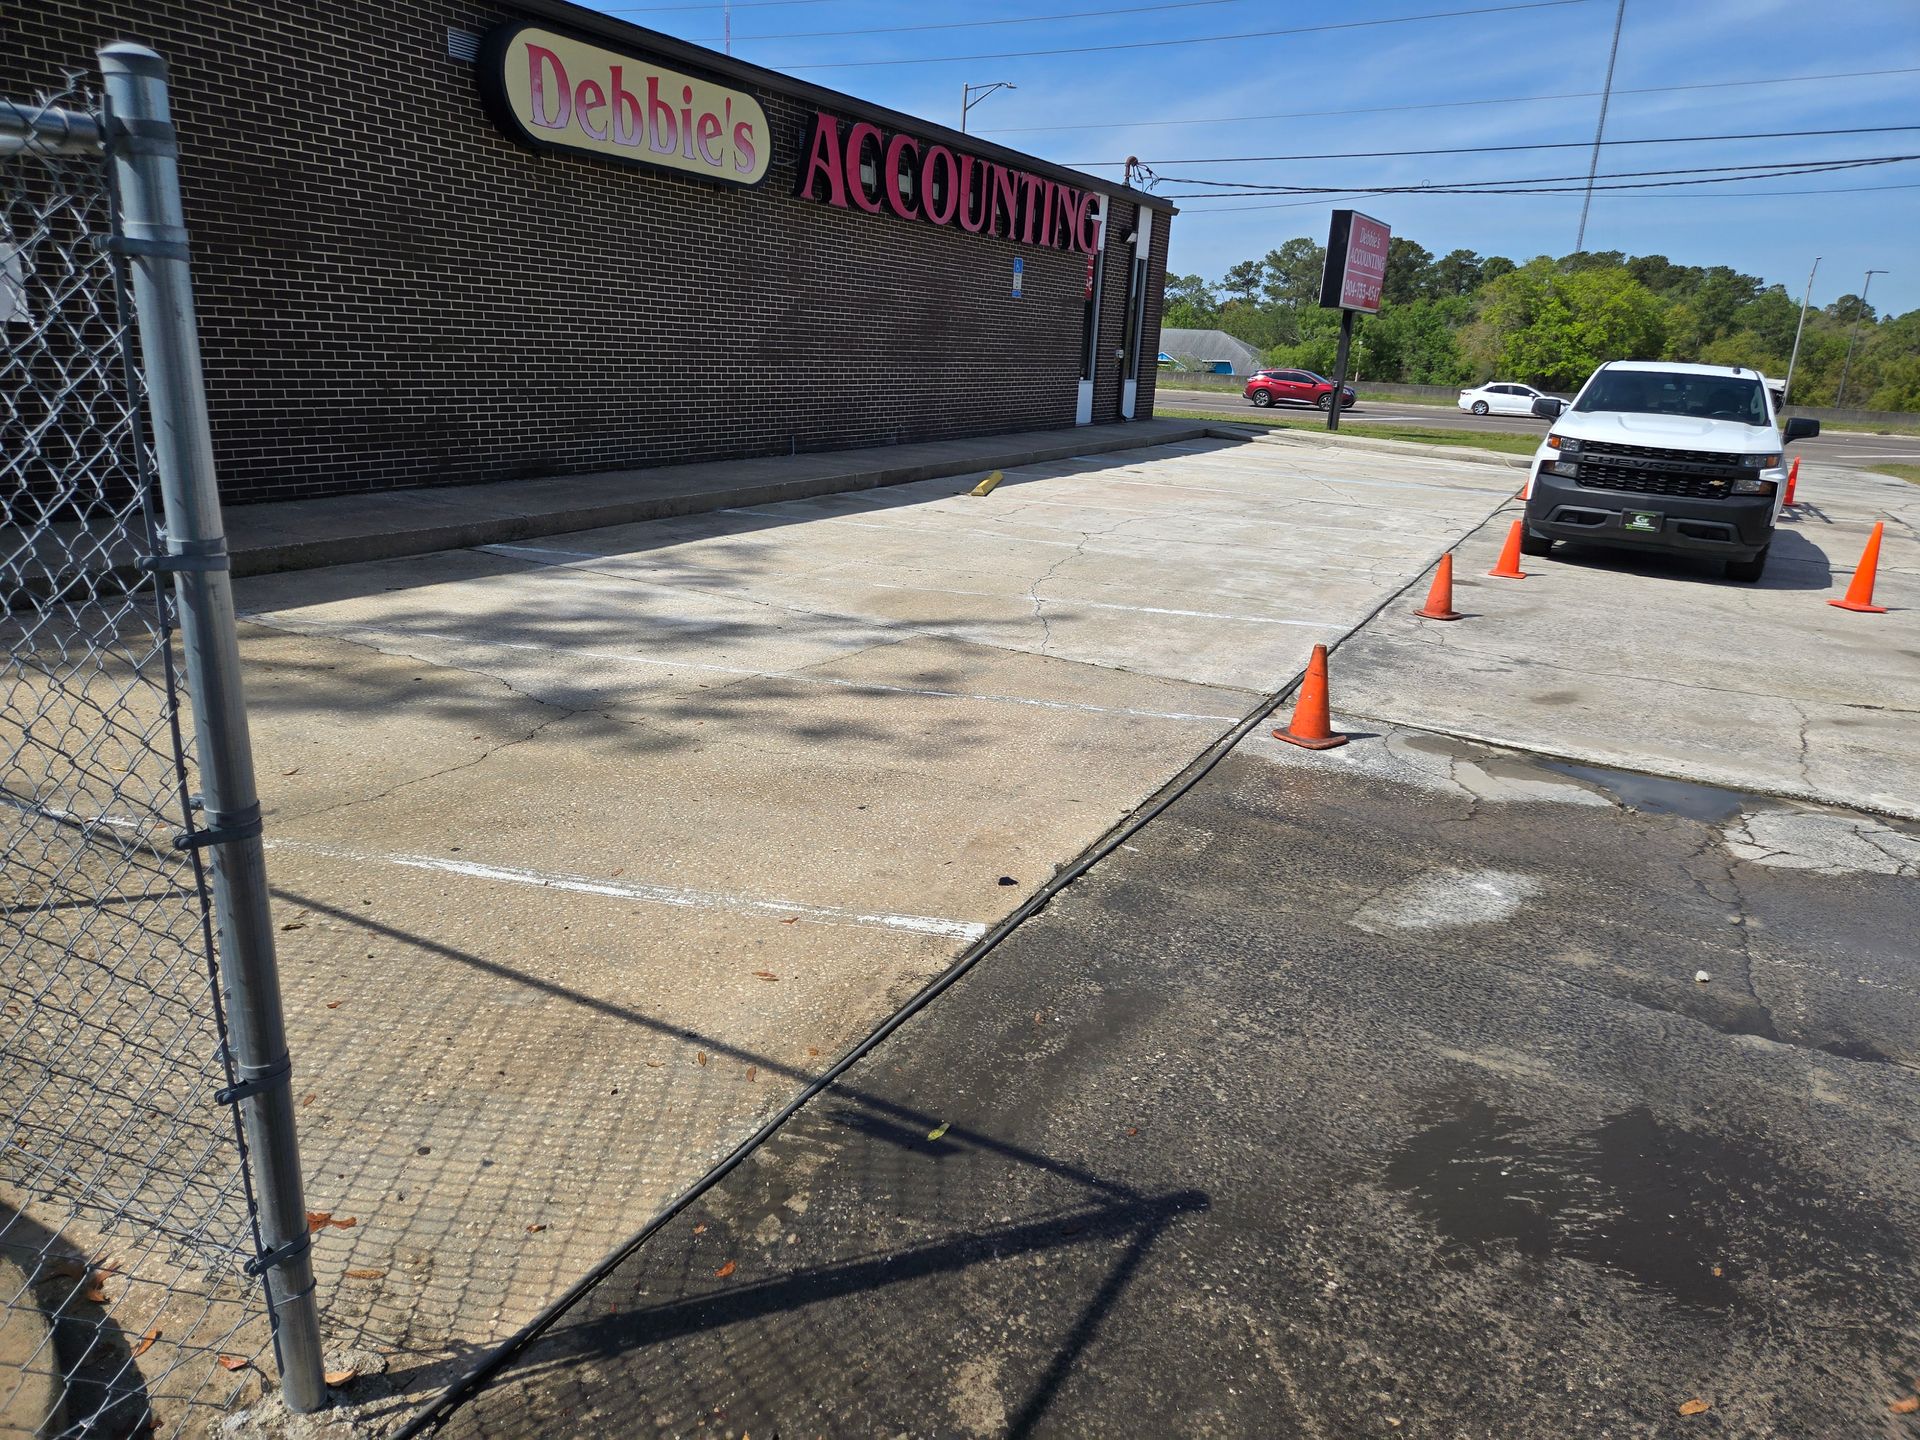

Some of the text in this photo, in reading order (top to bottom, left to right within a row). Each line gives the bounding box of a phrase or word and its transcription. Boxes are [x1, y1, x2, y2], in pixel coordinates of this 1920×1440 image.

[525, 42, 756, 175] Debbie's
[800, 110, 1104, 255] ACCOUNTING
[1359, 228, 1380, 248] Debbie's
[1350, 248, 1385, 271] ACCOUNTING
[1583, 454, 1732, 476] CHEVROLET
